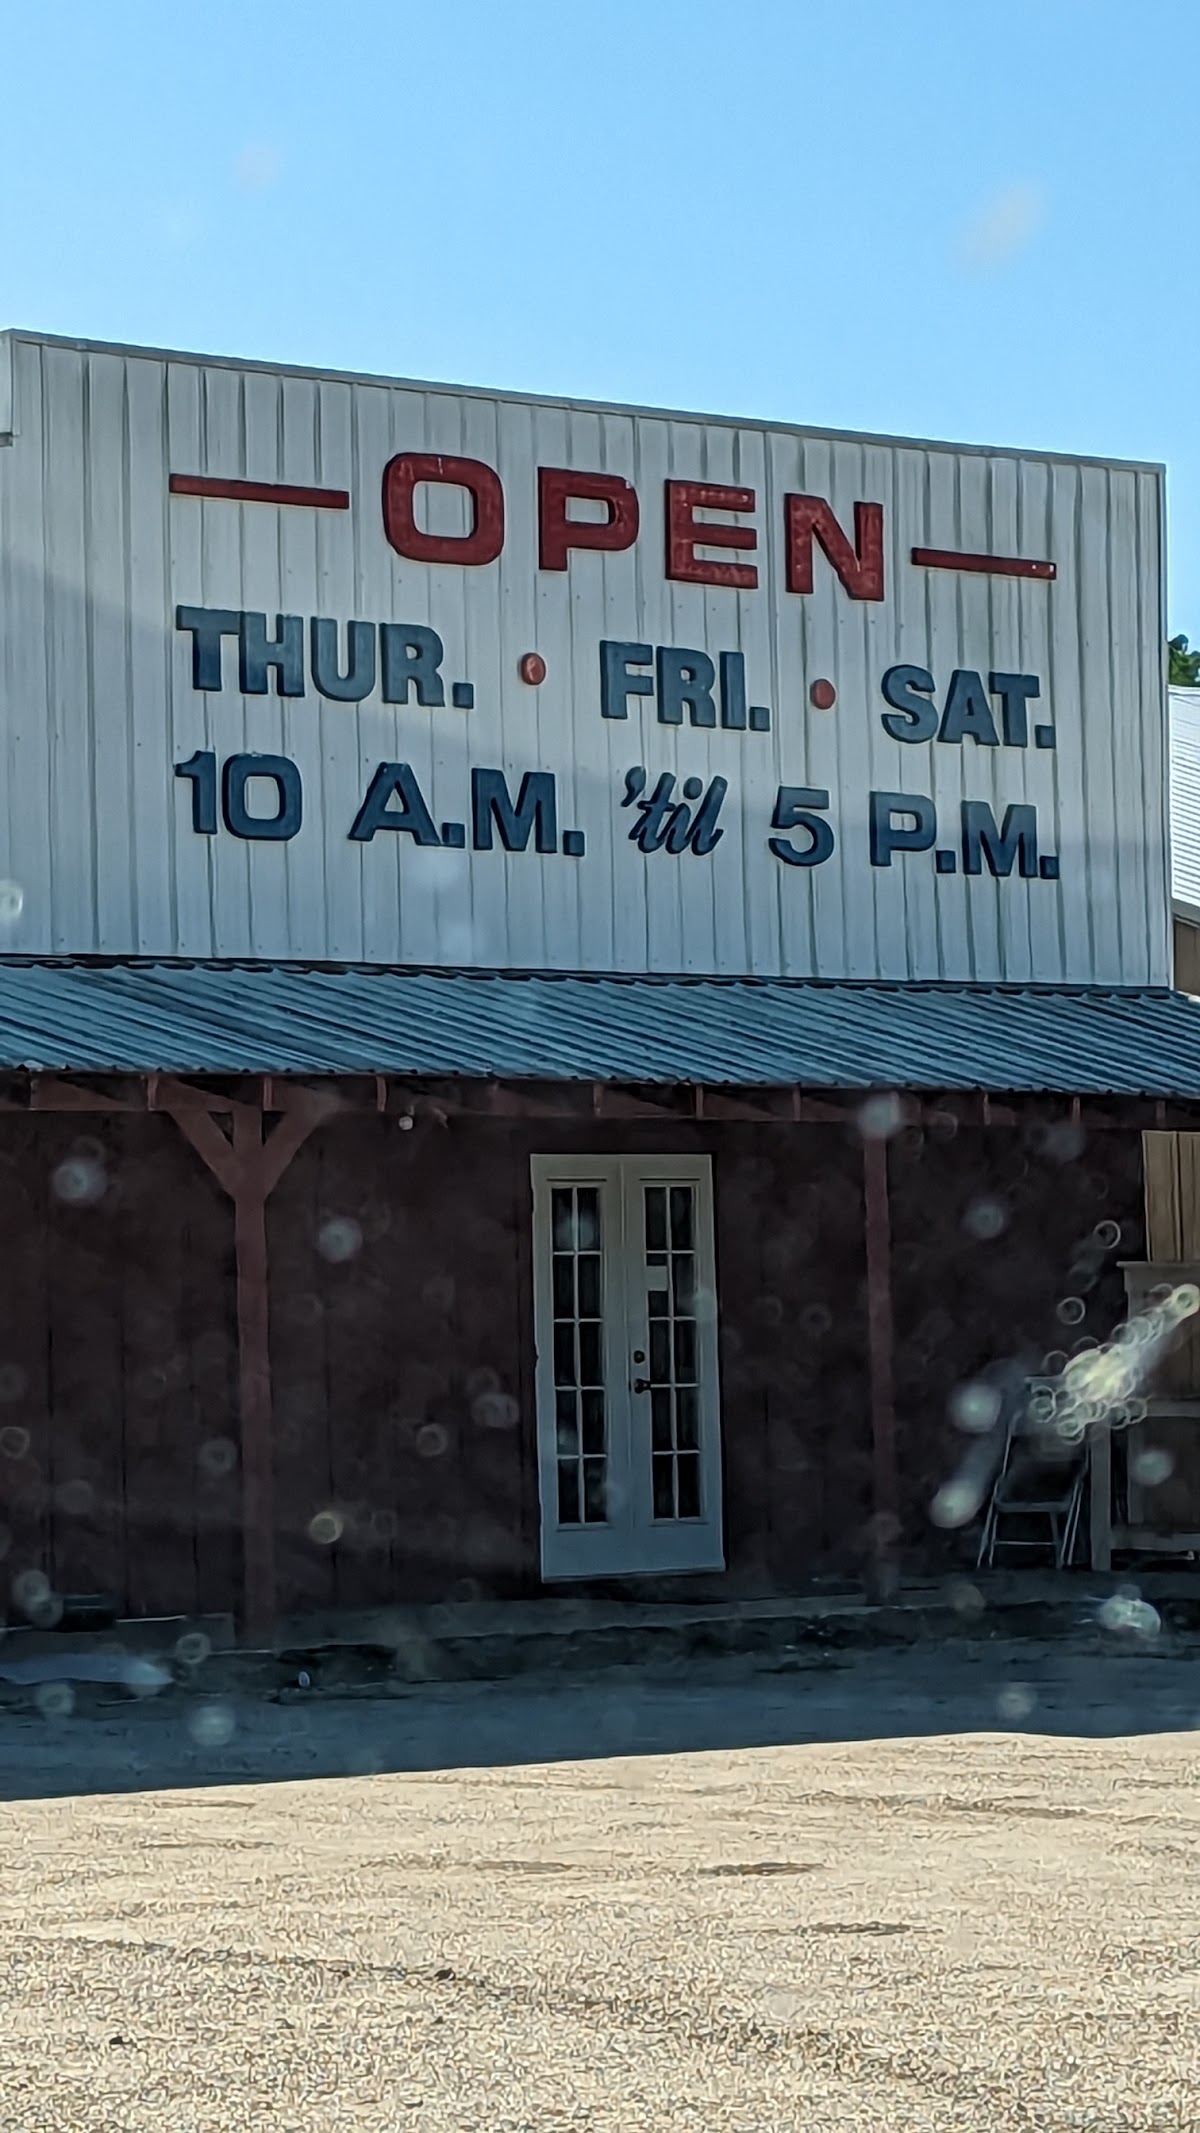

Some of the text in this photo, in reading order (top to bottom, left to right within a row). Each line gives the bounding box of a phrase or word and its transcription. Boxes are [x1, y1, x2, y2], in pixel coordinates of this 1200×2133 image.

[382, 452, 884, 601] OPEN
[176, 605, 1056, 749] THUR. FRI. SAT.
[175, 750, 1060, 879] 10 A.M. 'til 5 P.M.
